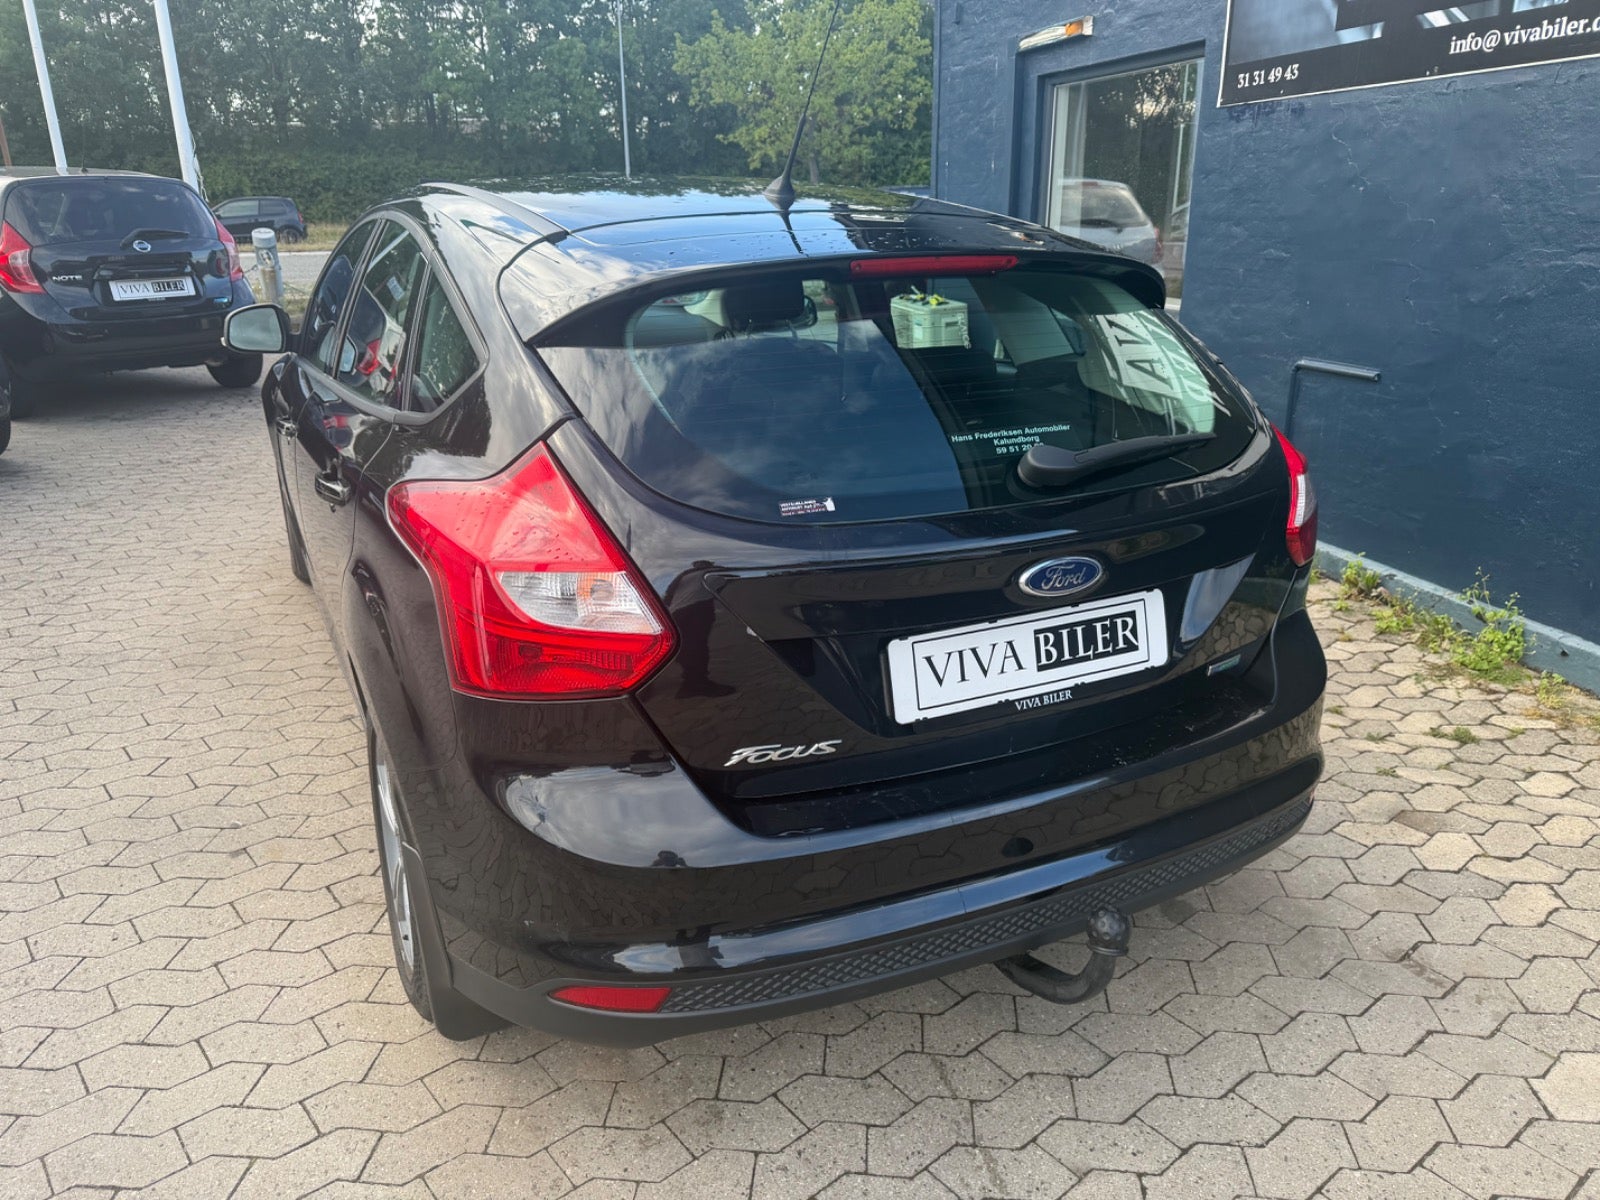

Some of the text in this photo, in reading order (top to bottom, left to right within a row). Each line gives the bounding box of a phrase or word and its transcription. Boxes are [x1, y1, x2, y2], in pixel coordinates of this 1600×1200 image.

[1237, 63, 1299, 89] 31 31 49 43
[119, 280, 185, 295] VIVA BILER
[951, 424, 1070, 443] Hans Frederiksen Automobiler
[993, 435, 1040, 446] Kalundborg
[996, 446, 1007, 454] 59
[1009, 445, 1019, 453] 51
[1041, 563, 1087, 590] Ford
[922, 616, 1139, 688] VIVA BILER
[1014, 689, 1073, 711] VIVA BILER
